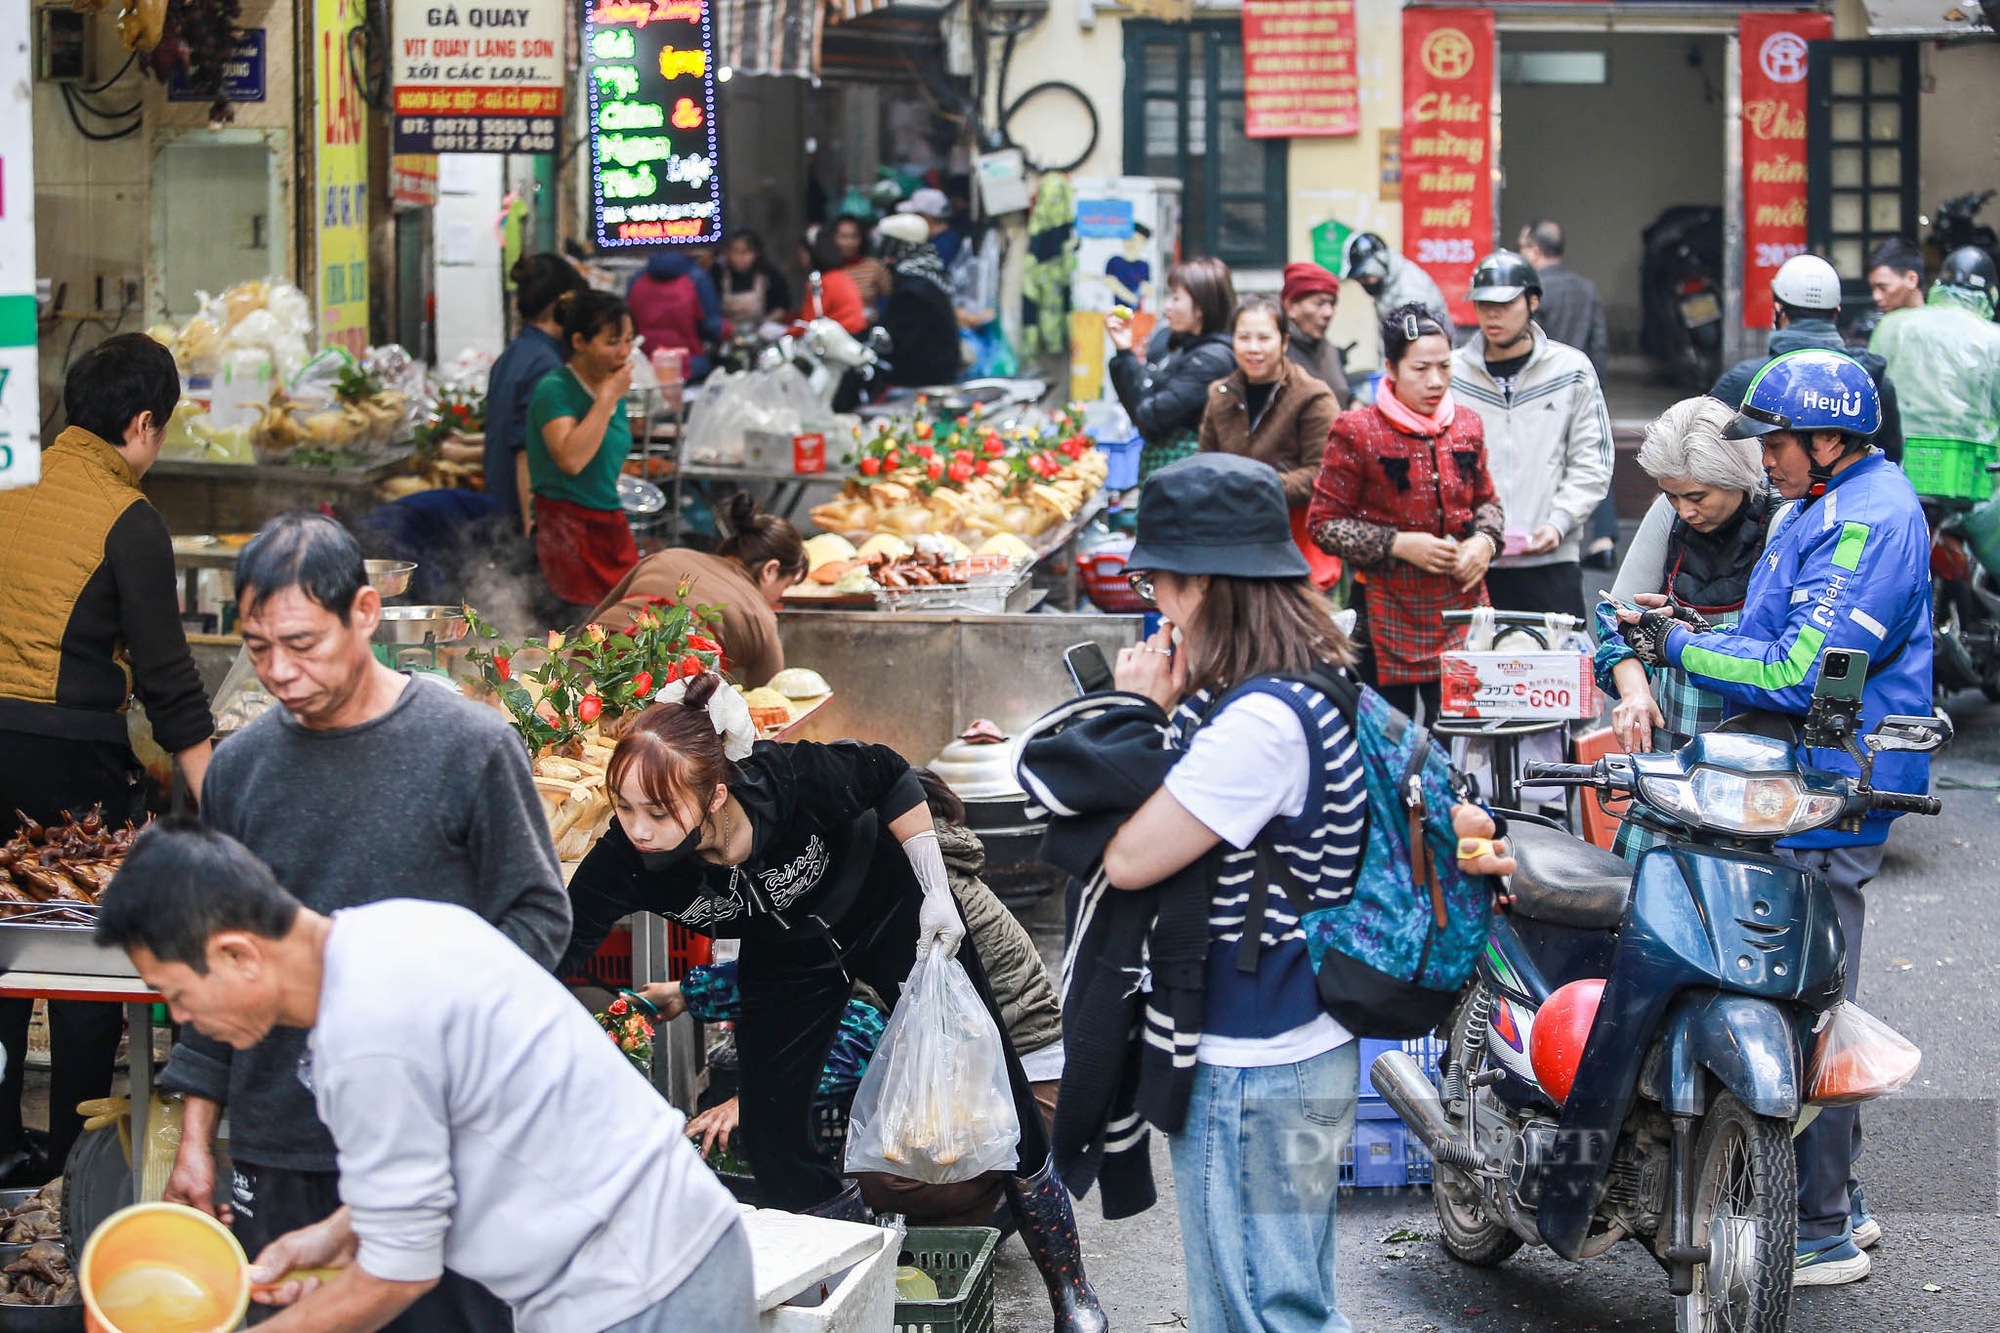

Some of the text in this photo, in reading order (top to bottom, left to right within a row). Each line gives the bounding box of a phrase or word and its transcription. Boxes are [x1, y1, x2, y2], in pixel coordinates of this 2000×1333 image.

[469, 8, 530, 28] QUAY
[404, 38, 427, 61] VỊT
[432, 38, 470, 58] QUAY
[475, 38, 517, 62] LẠNG
[445, 61, 485, 80] CÁC
[1742, 98, 1807, 140] Chà
[1410, 130, 1485, 164] mừng
[1418, 165, 1476, 191] năm
[1420, 199, 1473, 228] mới
[1417, 239, 1475, 263] 2025
[1530, 690, 1571, 708] 600
